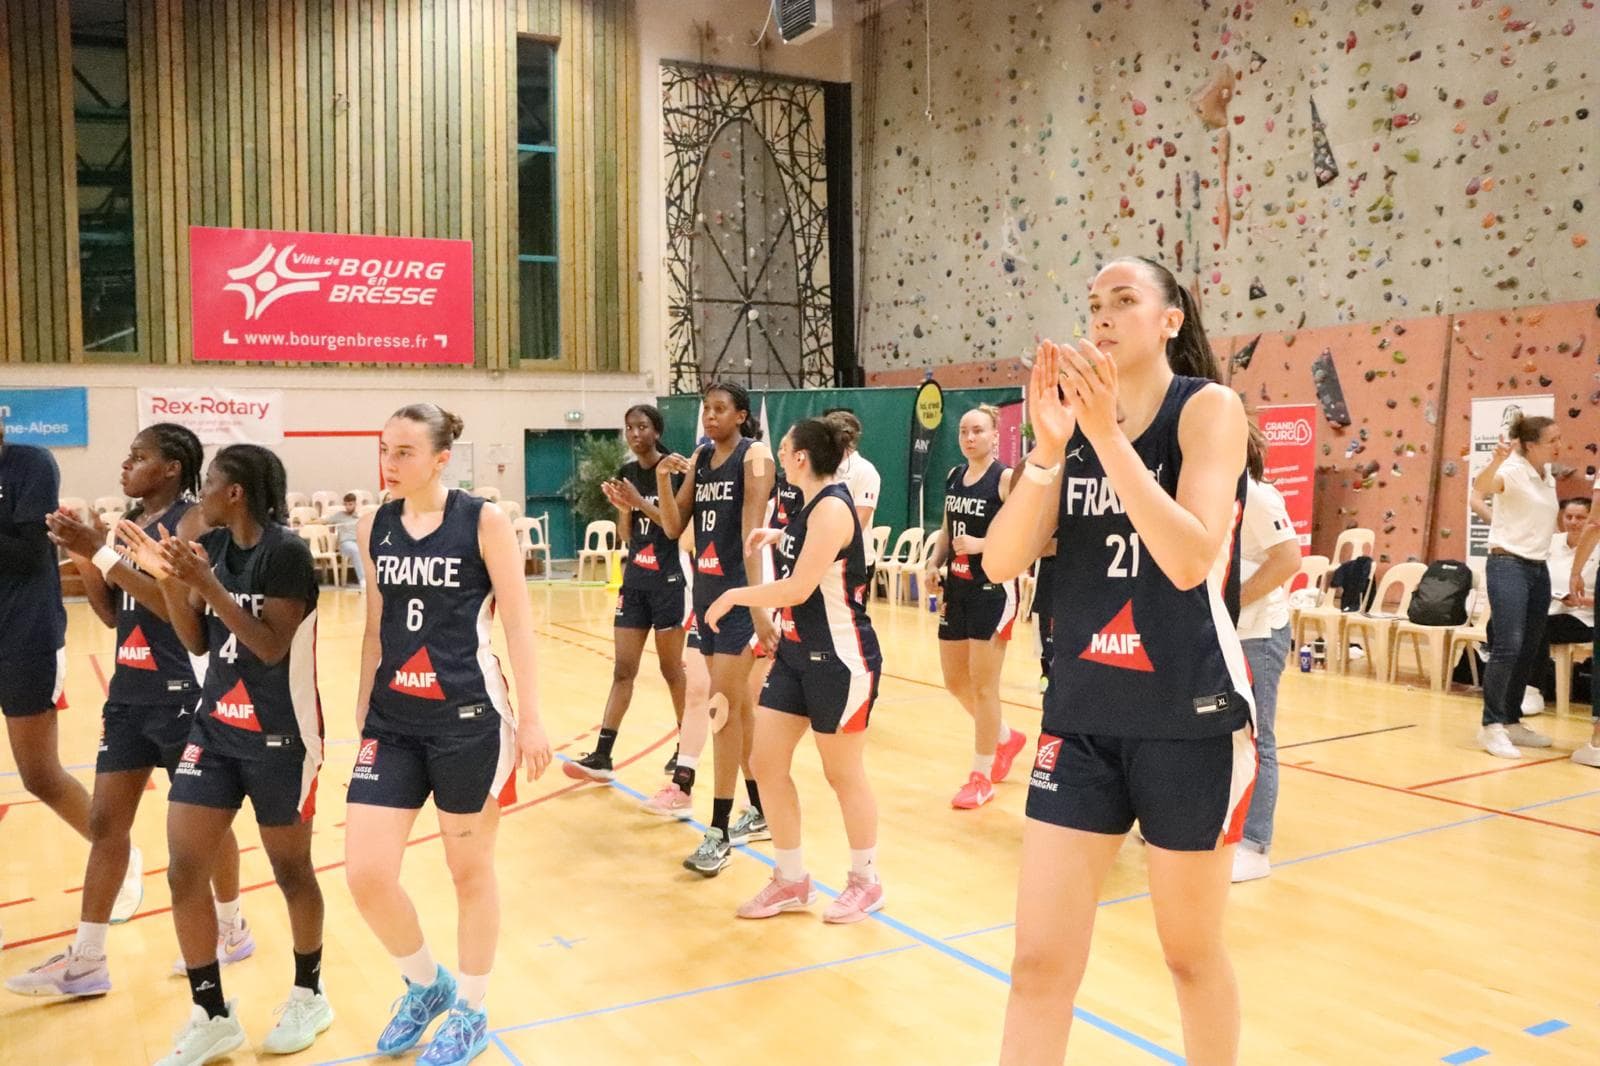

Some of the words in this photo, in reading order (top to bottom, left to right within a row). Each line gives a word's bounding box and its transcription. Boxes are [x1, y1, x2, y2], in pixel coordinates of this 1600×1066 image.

[292, 253, 320, 265] Ville
[325, 256, 340, 266] de
[338, 258, 446, 280] BOURG
[367, 276, 388, 286] en
[328, 284, 437, 305] BRESSE
[244, 331, 428, 351] www.bourgenbresse.fr
[152, 397, 269, 419] Rex-Rotary
[1265, 421, 1295, 430] GRAND
[945, 495, 987, 517] FRANCE
[639, 518, 650, 535] 17
[702, 510, 716, 532] 19
[635, 553, 656, 564] MAIF
[698, 558, 719, 569] MAIF
[1106, 532, 1139, 578] 21
[376, 556, 461, 587] FRANCE
[951, 562, 970, 573] MAIF
[406, 598, 424, 631] 6
[119, 646, 150, 661] MAIF
[219, 632, 238, 664] 4
[1091, 633, 1141, 655] MAIF
[395, 670, 437, 688] MAIF
[217, 702, 254, 719] MAIF
